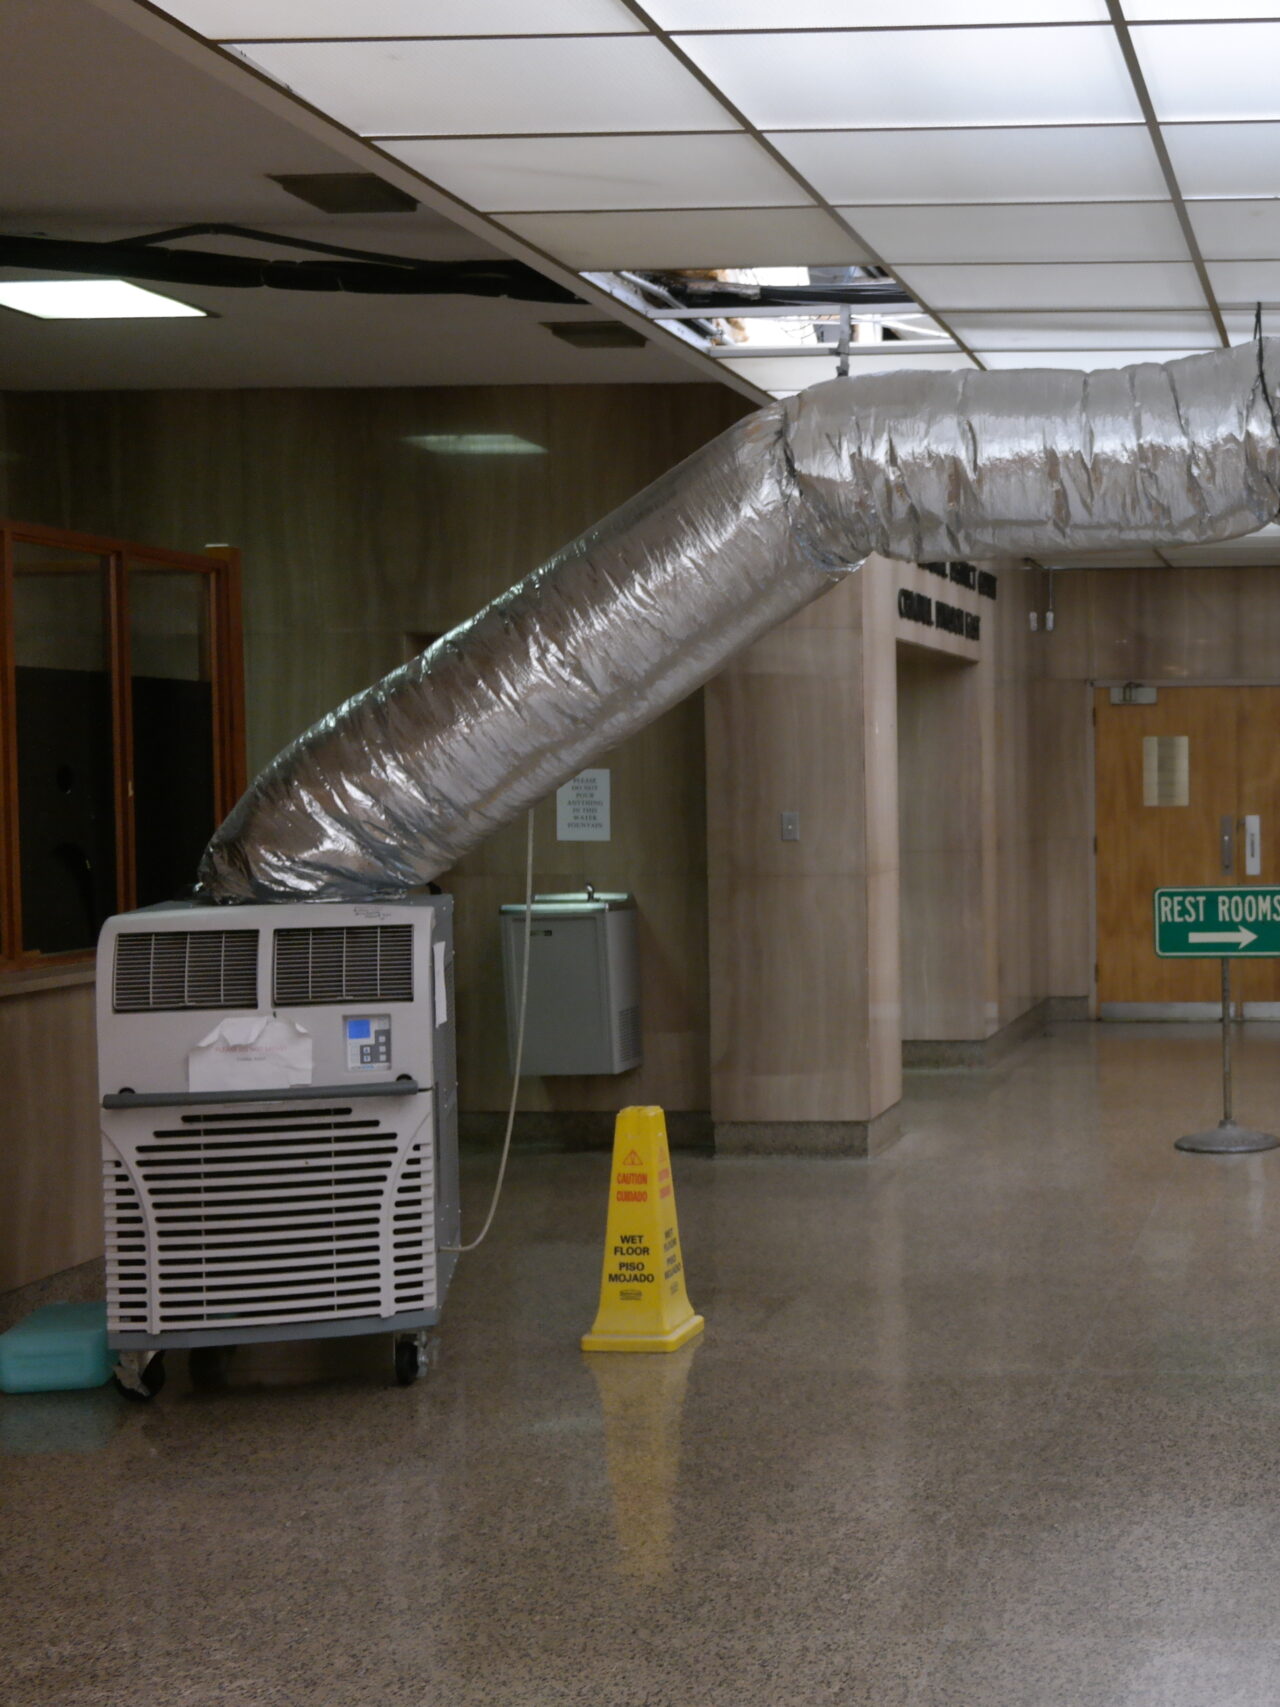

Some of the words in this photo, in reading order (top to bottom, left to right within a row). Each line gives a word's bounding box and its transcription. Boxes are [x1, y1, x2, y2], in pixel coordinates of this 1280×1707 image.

[1160, 895, 1206, 923] REST
[616, 1173, 648, 1185] CAUTION
[616, 1190, 648, 1202] CUIDADO
[620, 1235, 644, 1245] WET
[613, 1245, 650, 1256] FLOOR
[618, 1261, 645, 1272] PISO
[608, 1272, 655, 1284] MOJADO
